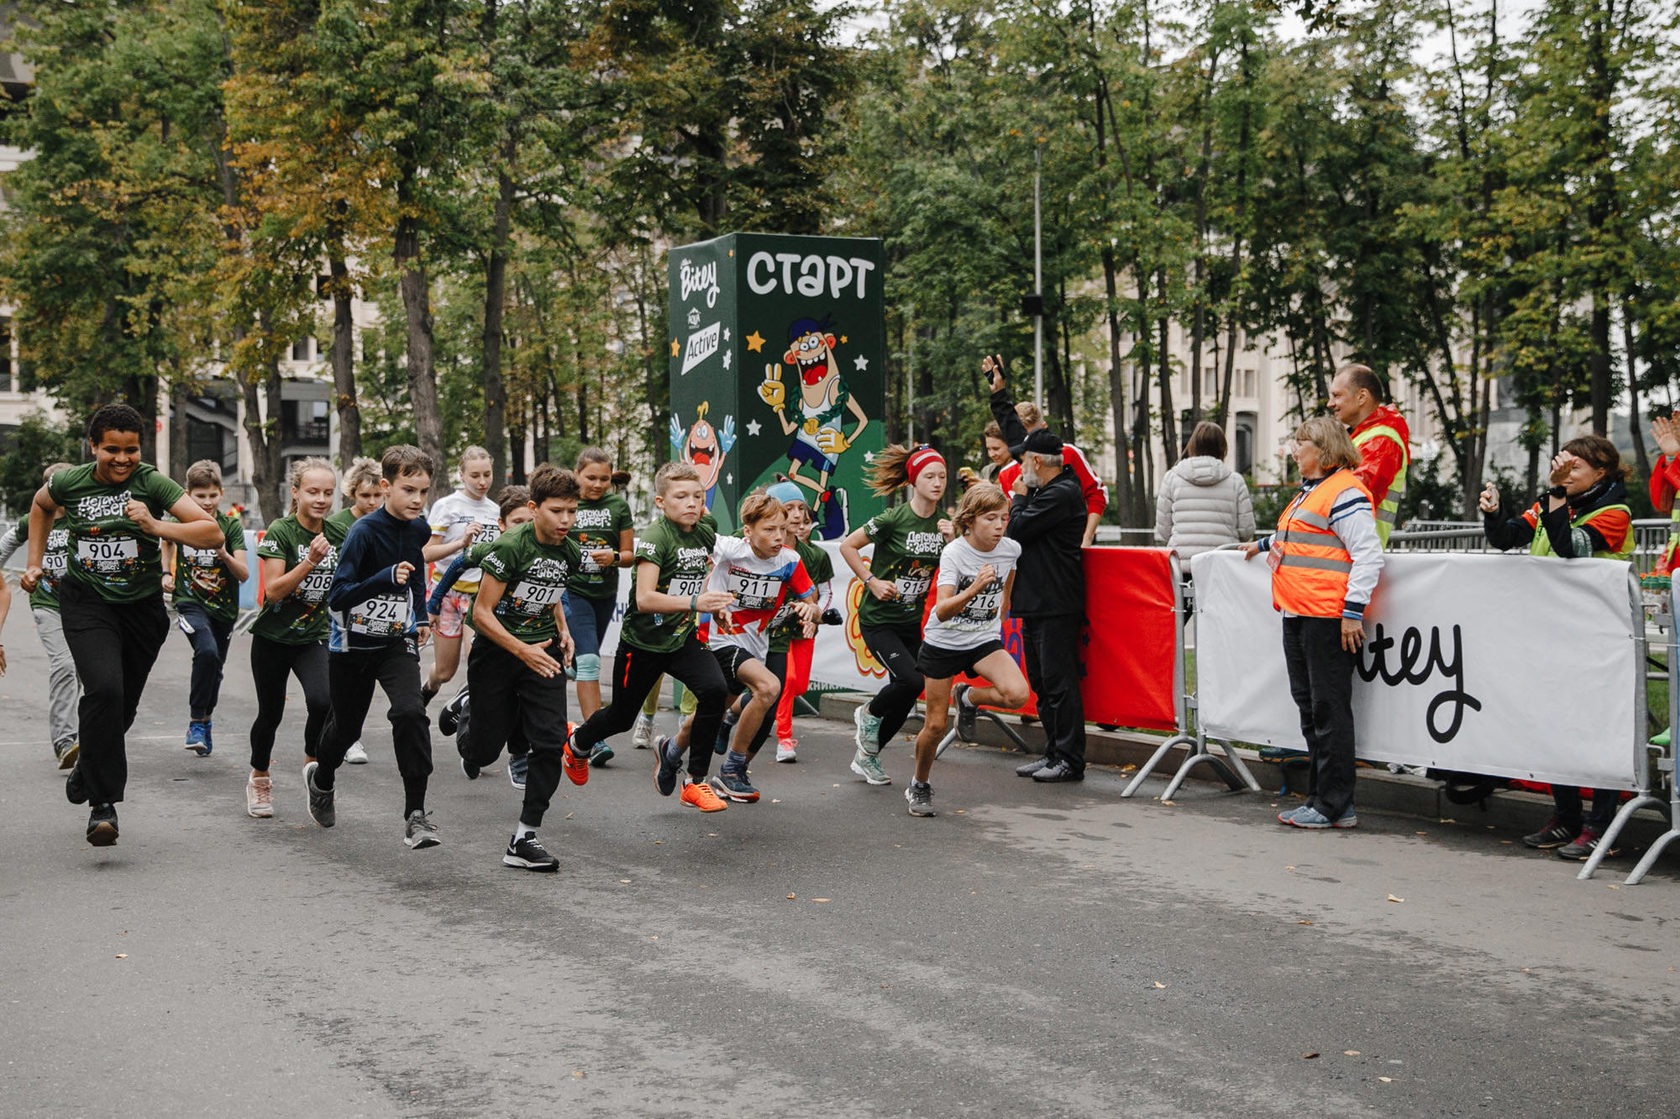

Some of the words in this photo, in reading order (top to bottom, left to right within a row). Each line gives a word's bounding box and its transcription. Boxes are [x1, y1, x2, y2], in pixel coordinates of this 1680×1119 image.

[680, 259, 720, 308] Bitey
[687, 332, 717, 362] Active
[89, 543, 125, 559] 904
[46, 556, 66, 568] 90
[304, 575, 332, 590] 908
[740, 579, 768, 596] 911
[903, 582, 926, 593] 915
[526, 586, 555, 603] 901
[366, 600, 397, 620] 924
[1355, 623, 1482, 744] itey
